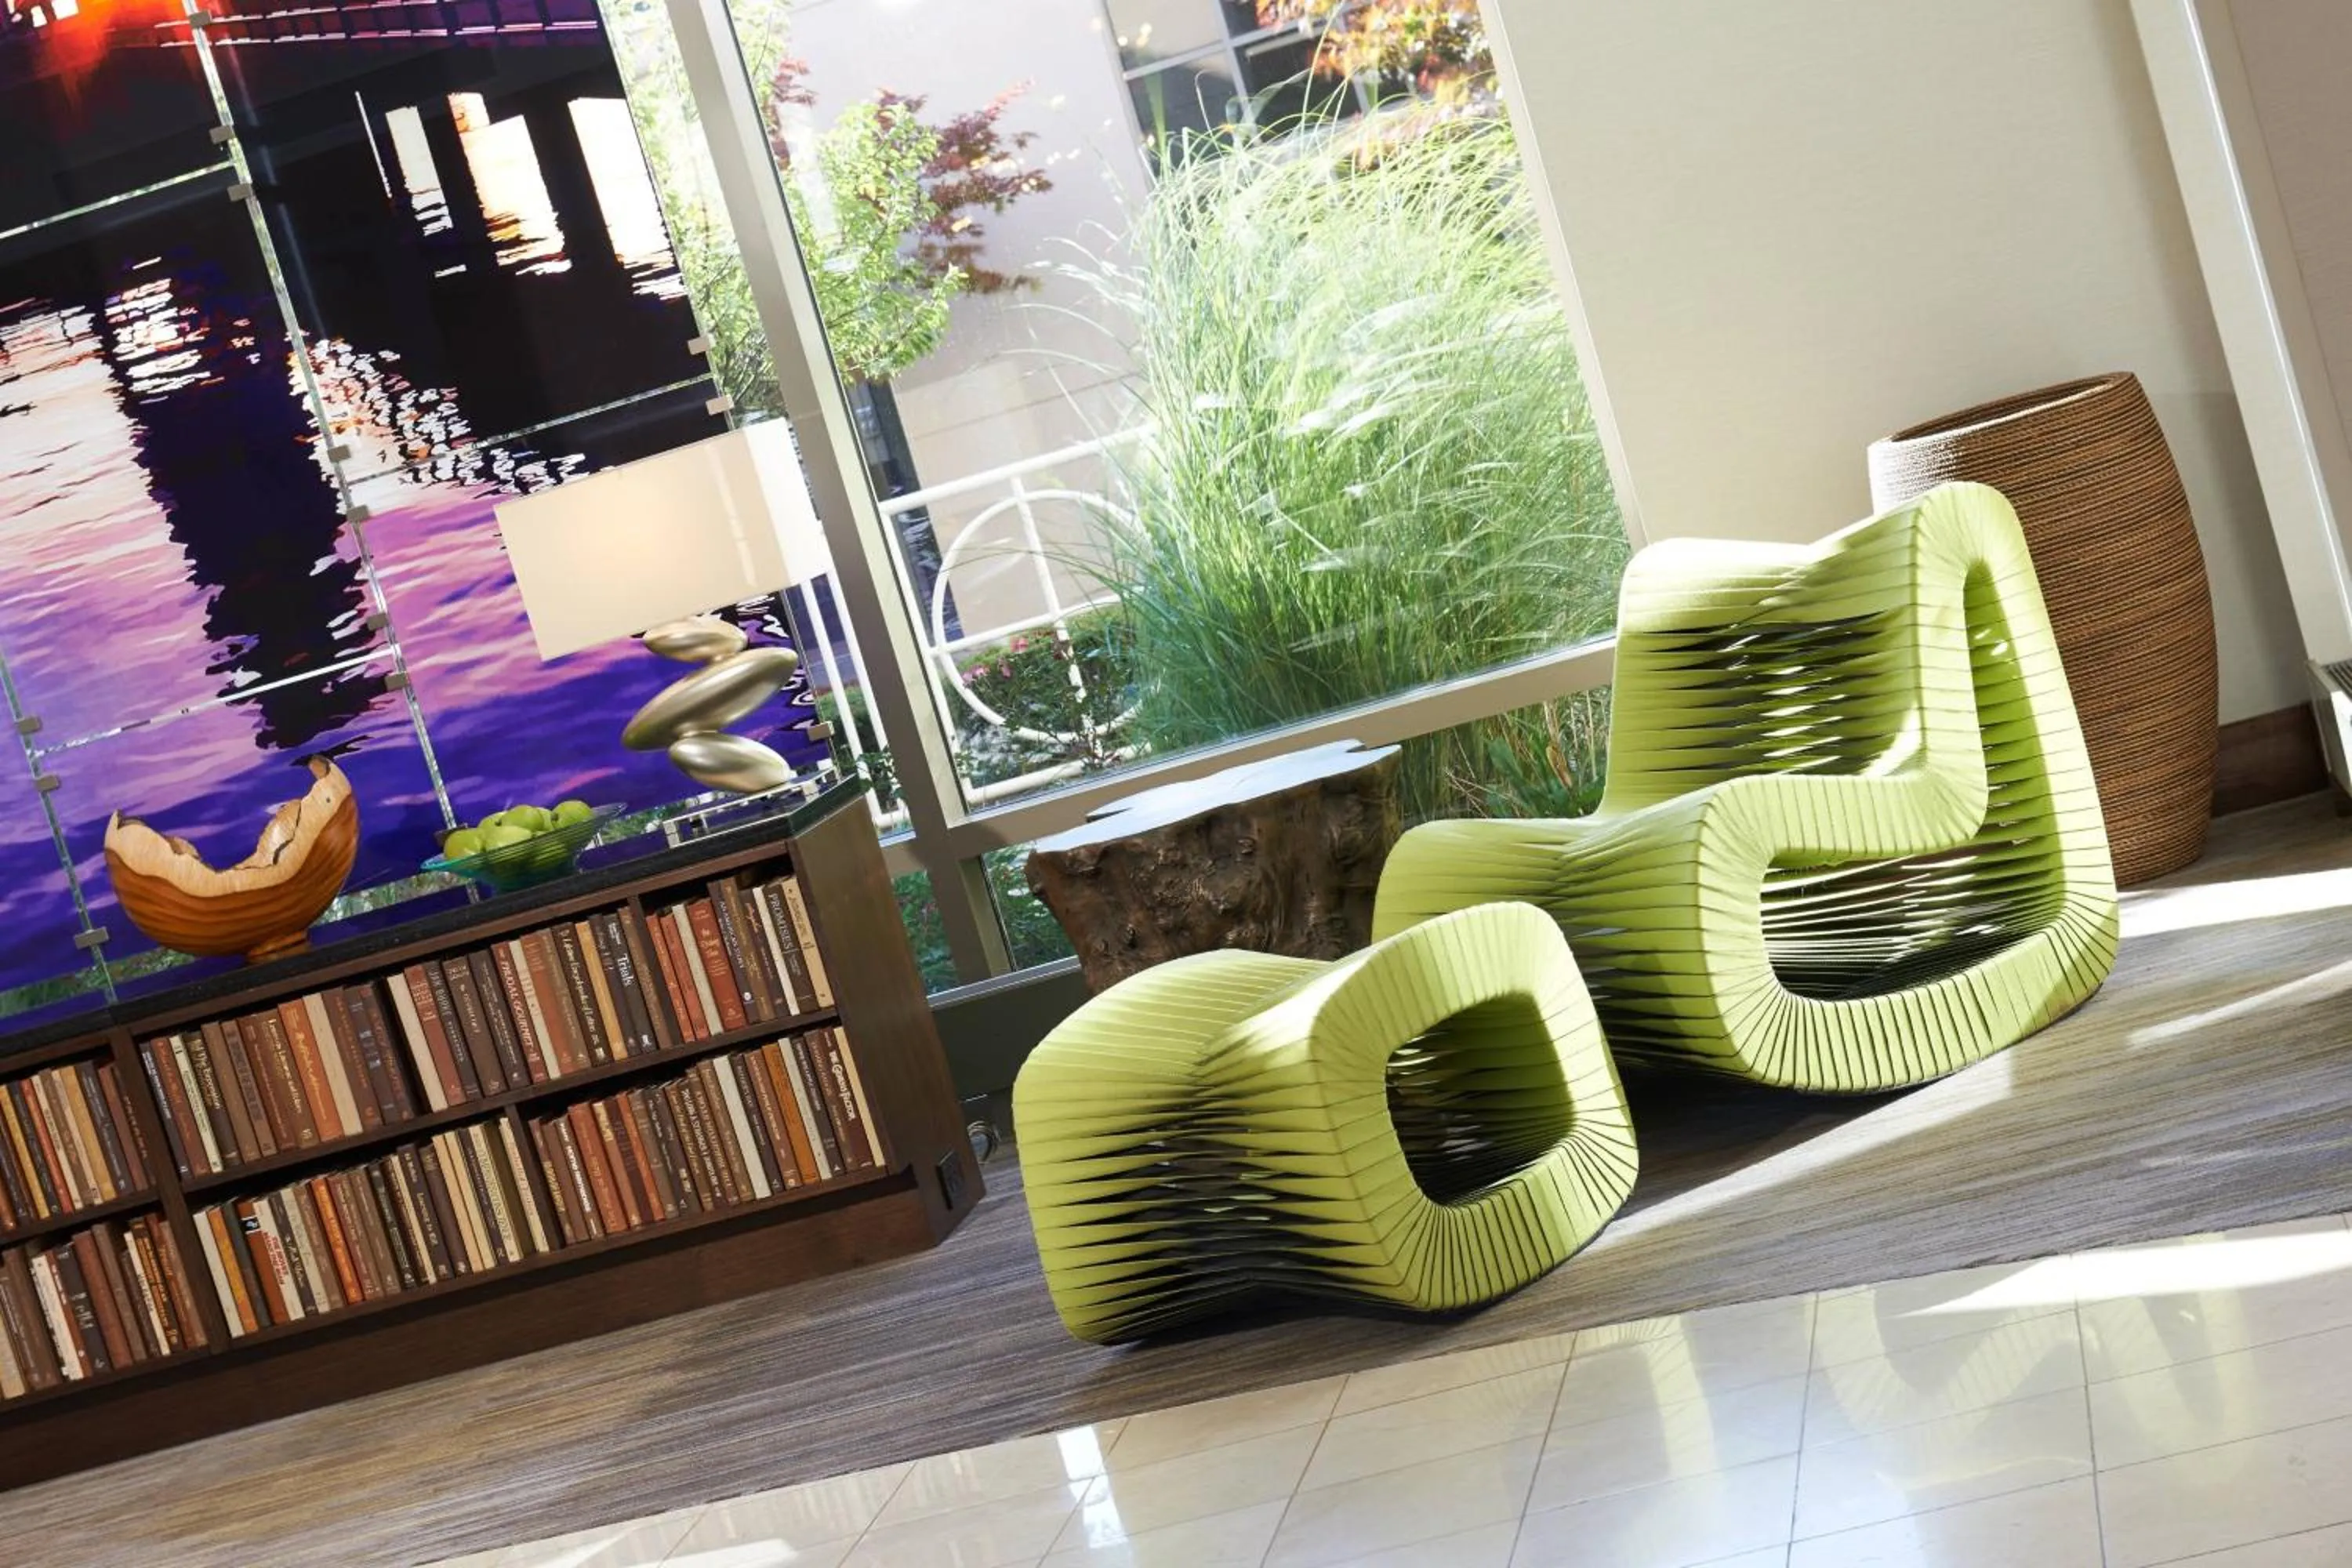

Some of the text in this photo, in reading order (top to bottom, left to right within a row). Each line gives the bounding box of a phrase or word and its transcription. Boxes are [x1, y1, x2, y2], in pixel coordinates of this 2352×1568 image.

[767, 892, 793, 949] PROMISES
[615, 953, 635, 986] Trials
[512, 1000, 535, 1050] GOURMET
